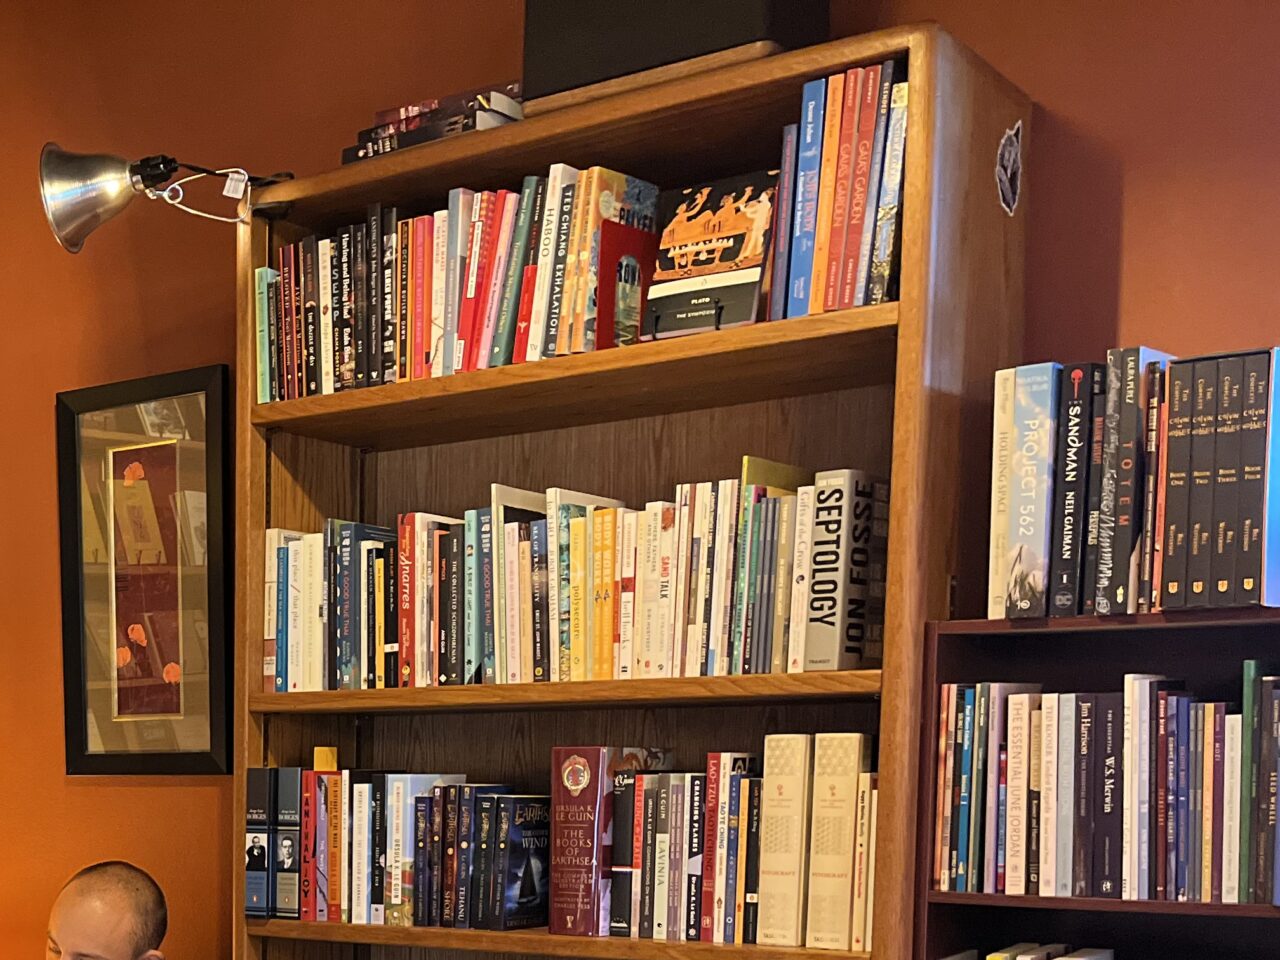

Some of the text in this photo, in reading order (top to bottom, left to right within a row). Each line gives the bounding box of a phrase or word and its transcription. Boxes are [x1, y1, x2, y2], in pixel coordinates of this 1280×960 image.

[833, 180, 847, 227] GARDEN
[851, 140, 870, 224] GAIA'S GARDEN
[541, 208, 555, 258] HABOO
[341, 233, 350, 301] Having Being
[549, 190, 573, 336] TED CHIANG EXHALATION
[998, 431, 1010, 482] HOLDING
[1019, 419, 1039, 536] PROJECT 562
[1062, 406, 1084, 559] SANDMAN NEIL GAIMAN
[1119, 440, 1133, 526] TOTEM
[659, 556, 670, 599] SAND TALK
[809, 488, 844, 627] SEPTOLOGY
[845, 480, 874, 659] JON FOSSE
[572, 585, 582, 641] polysecure
[1079, 702, 1091, 754] Jim Harrison
[692, 780, 701, 821] CHANGING
[1009, 702, 1023, 858] THE ESSENTIAL JUNE JORDAN
[1104, 756, 1115, 813] W.S. Merwin
[556, 839, 592, 848] BOOKS
[563, 830, 584, 838] THE
[568, 812, 594, 821] GUIN
[552, 856, 597, 866] EARTHSEA
[657, 840, 667, 886] LAVINIA
